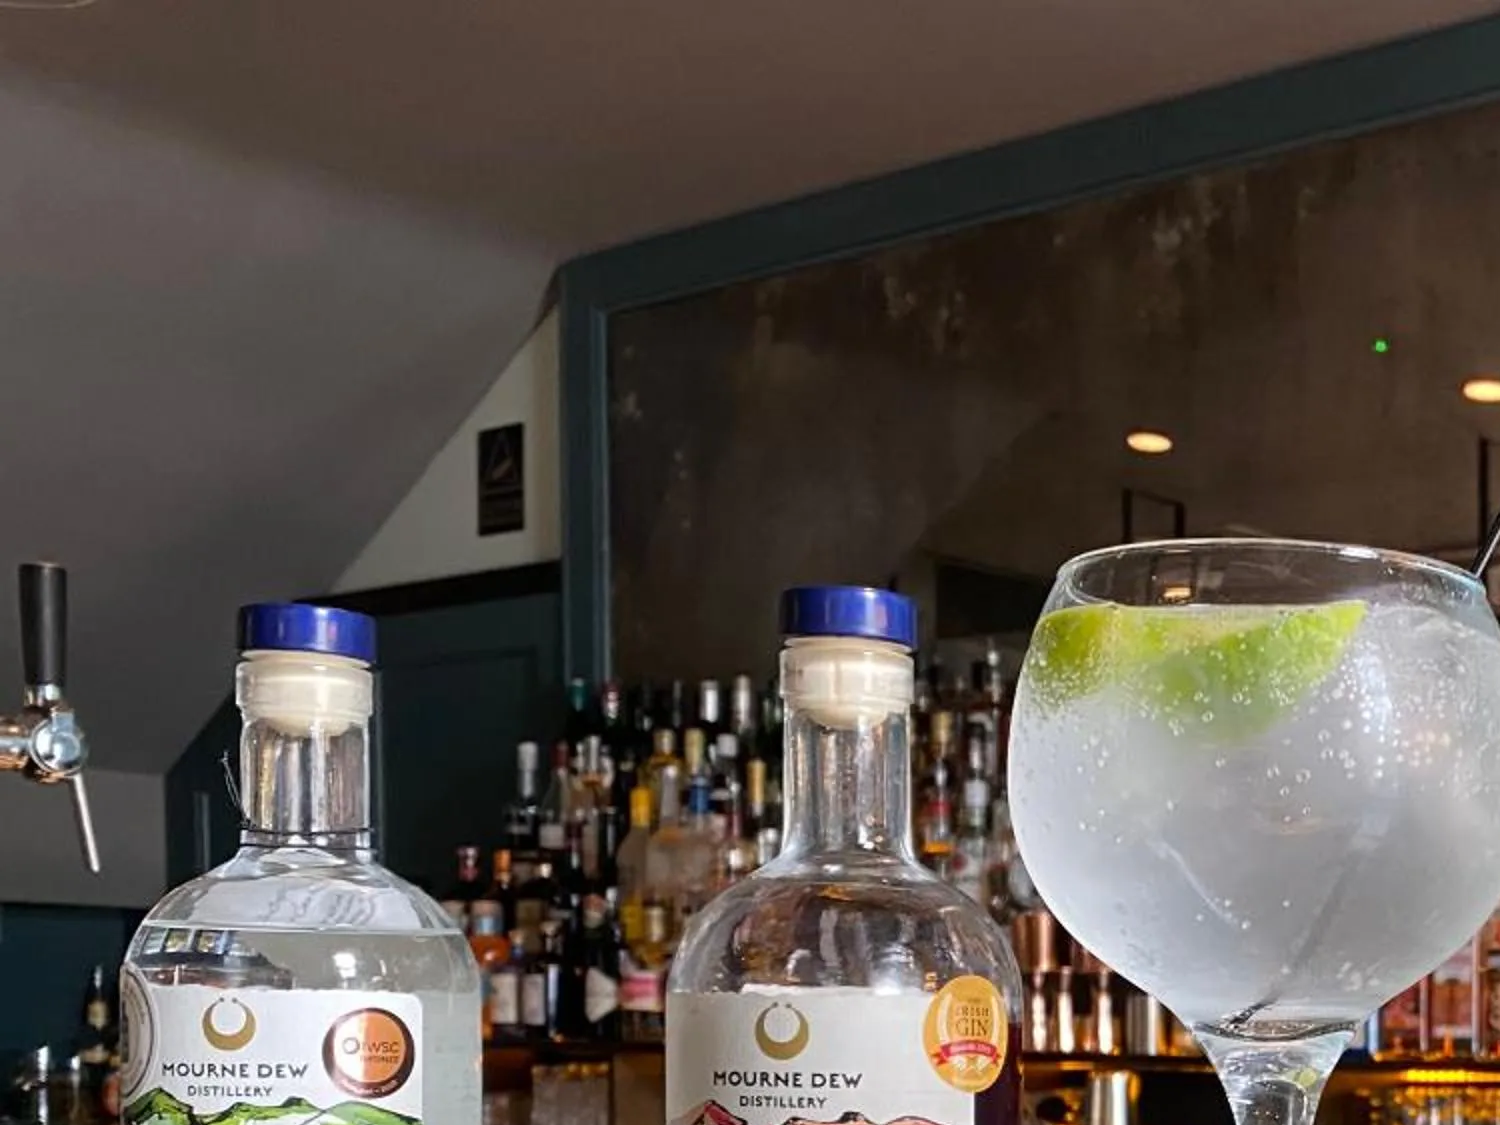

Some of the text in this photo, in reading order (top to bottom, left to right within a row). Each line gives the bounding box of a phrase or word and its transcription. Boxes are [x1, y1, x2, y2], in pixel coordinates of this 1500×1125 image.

[955, 1006, 989, 1017] IRISH
[955, 1018, 989, 1036] GIN
[161, 1063, 309, 1079] MOURNE DEW
[713, 1071, 863, 1089] MOURNE DEW
[187, 1085, 273, 1098] DISTILLERY
[739, 1094, 828, 1109] DISTILLERY
